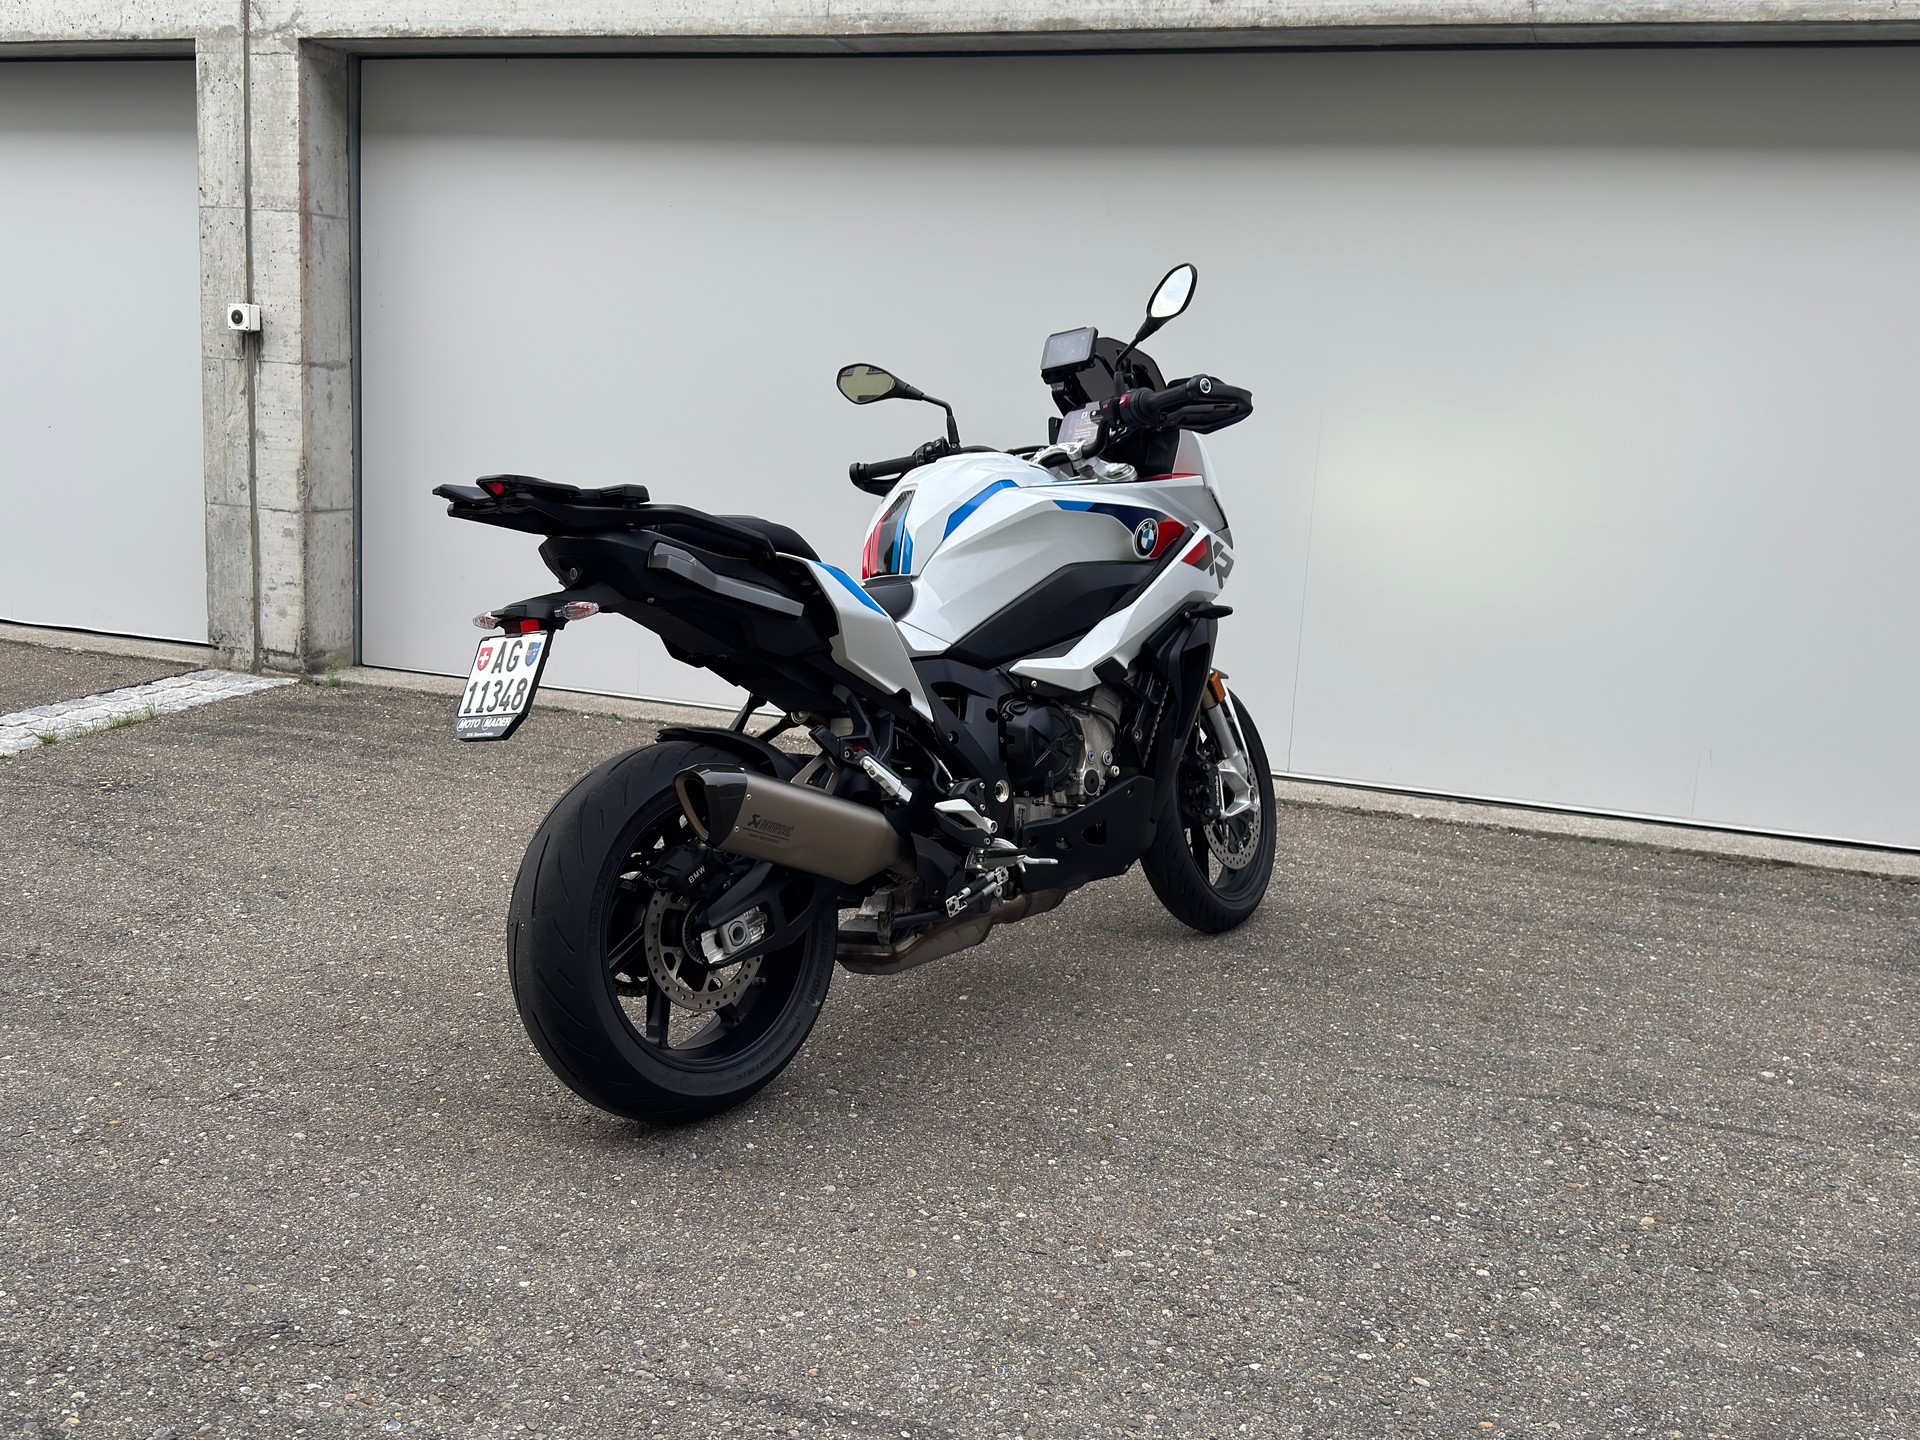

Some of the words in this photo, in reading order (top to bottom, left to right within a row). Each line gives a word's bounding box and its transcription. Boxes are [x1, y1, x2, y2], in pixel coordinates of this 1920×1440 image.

[491, 640, 523, 674] AG
[463, 678, 528, 714] 11348
[457, 718, 481, 731] MOTO
[688, 865, 705, 883] BMW
